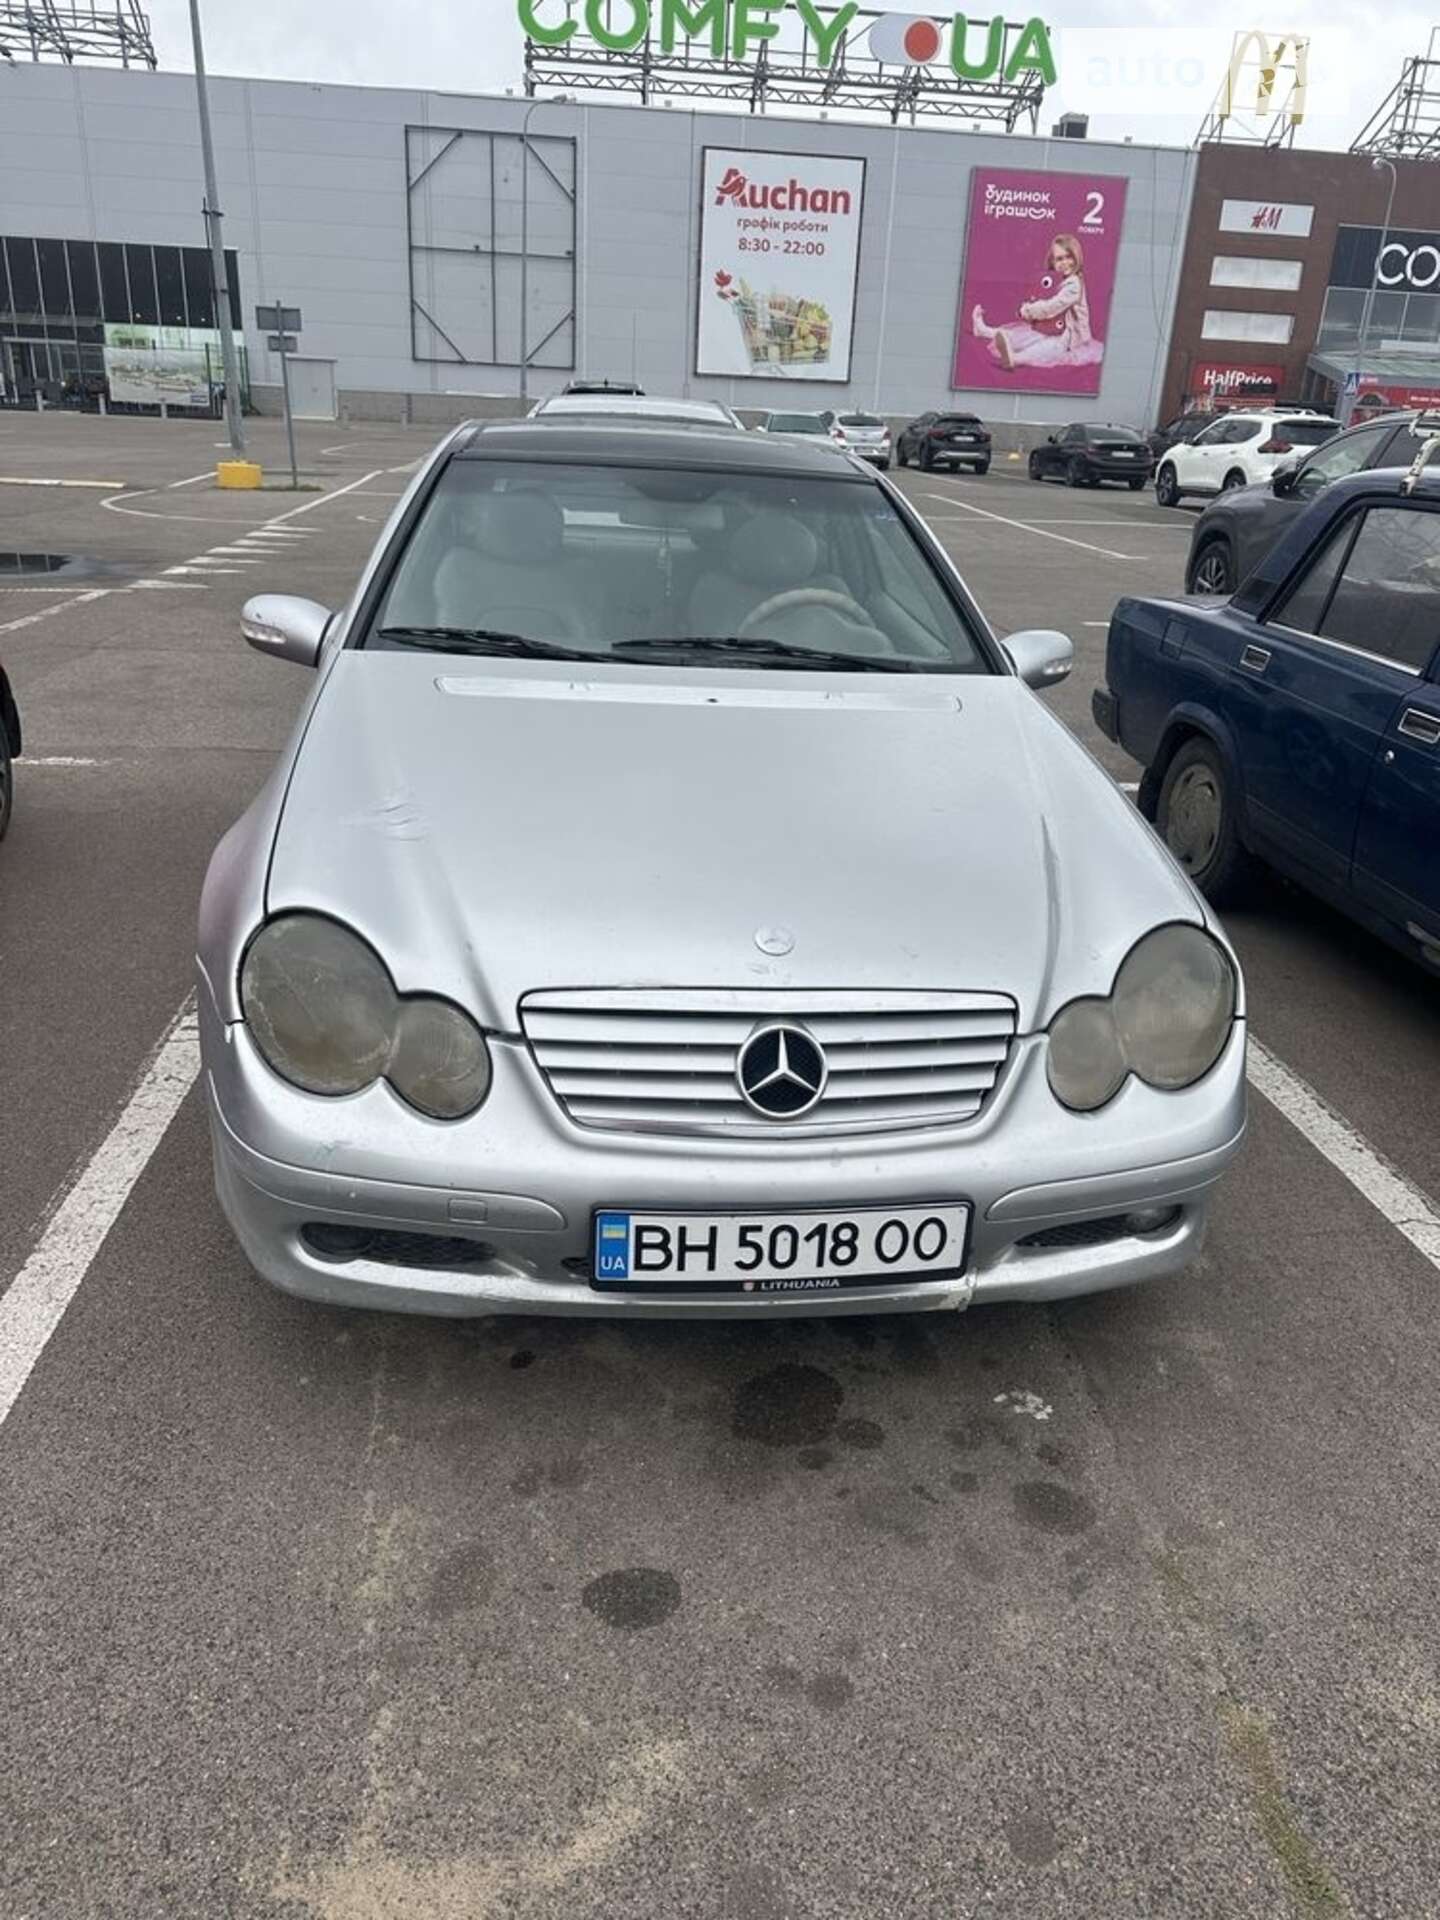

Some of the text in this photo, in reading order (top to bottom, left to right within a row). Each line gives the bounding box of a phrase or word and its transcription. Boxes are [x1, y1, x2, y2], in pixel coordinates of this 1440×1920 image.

[517, 0, 1058, 87] COMFY UA
[715, 168, 850, 215] Auchan
[985, 184, 1051, 203] будинок
[1083, 192, 1104, 223] 2
[737, 217, 828, 233] графік роботи
[739, 238, 770, 251] 8:30
[783, 240, 825, 255] 22:00
[634, 1224, 717, 1272] BH
[734, 1221, 859, 1271] 5018
[601, 1256, 625, 1270] UA
[761, 1279, 840, 1289] LITHUANIA
